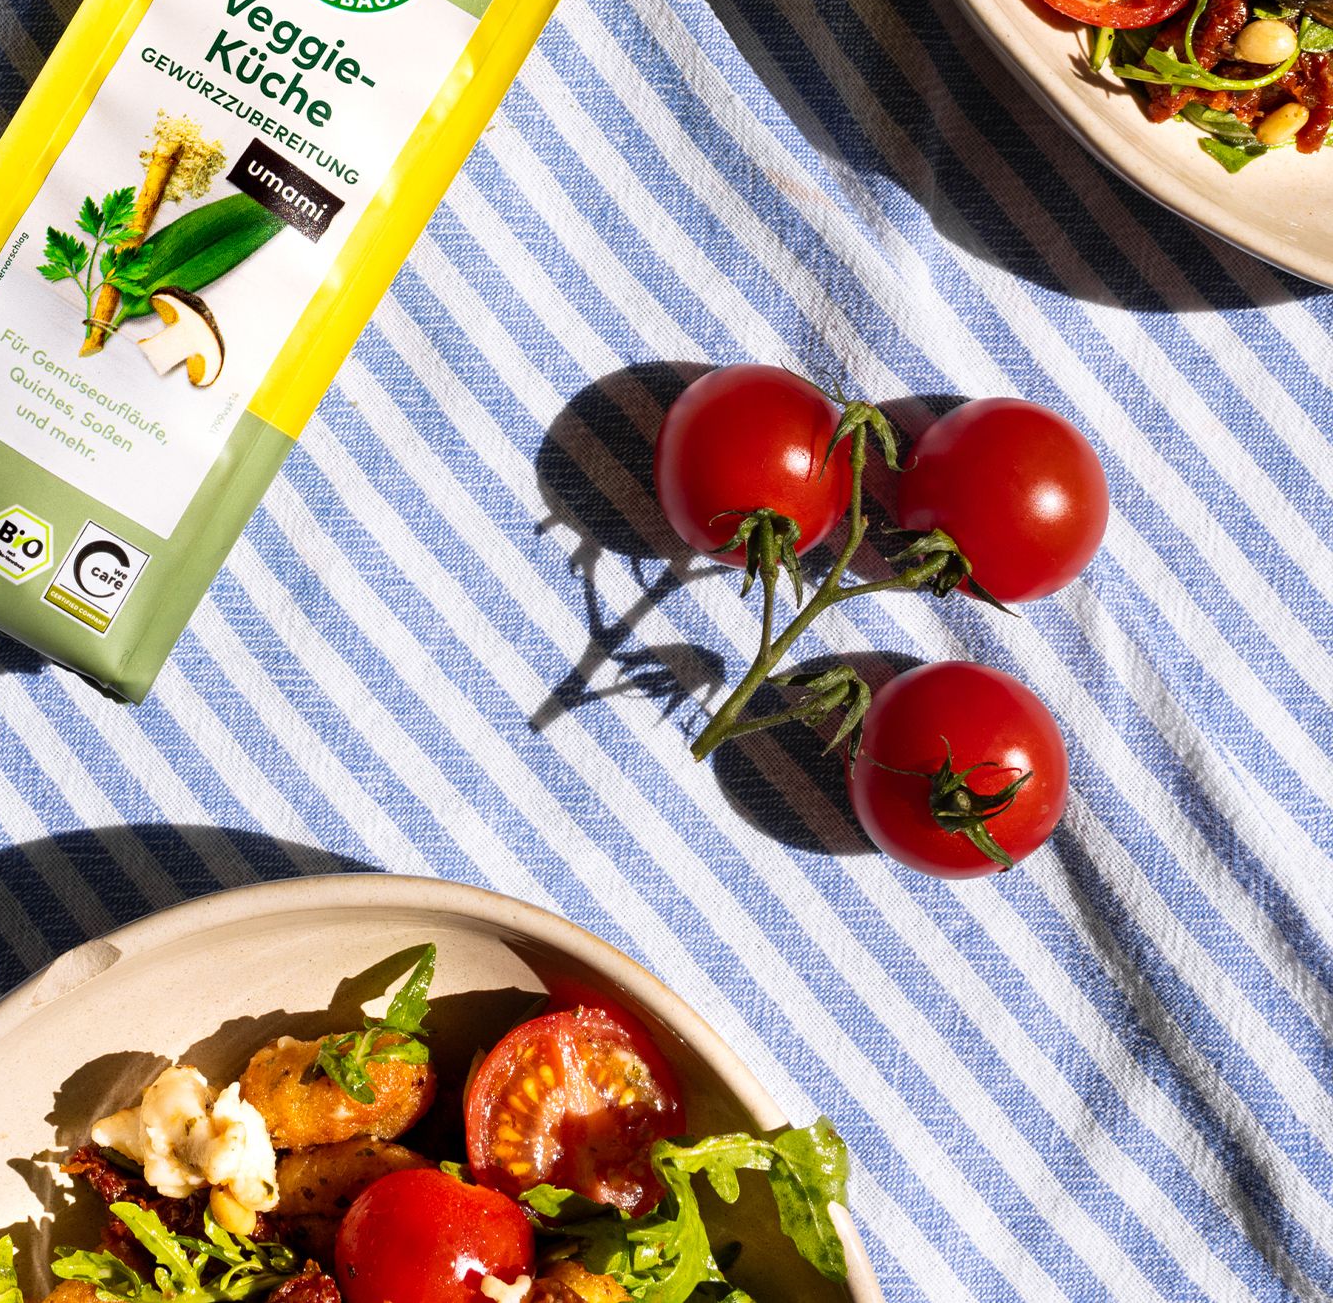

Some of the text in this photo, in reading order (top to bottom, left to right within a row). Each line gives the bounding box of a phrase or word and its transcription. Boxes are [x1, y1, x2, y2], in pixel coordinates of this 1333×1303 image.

[204, 29, 332, 127] Küche
[141, 47, 359, 185] GEWÜRZZUBEREITUNG
[247, 160, 329, 222] umami
[0, 328, 169, 445] Für Gemüseaufläufe,
[9, 367, 133, 452] Quiches, Soßen
[16, 404, 96, 462] und mehr.
[90, 567, 123, 590] care
[113, 567, 128, 579] we
[50, 590, 107, 627] CERTIFIED COMPANY
